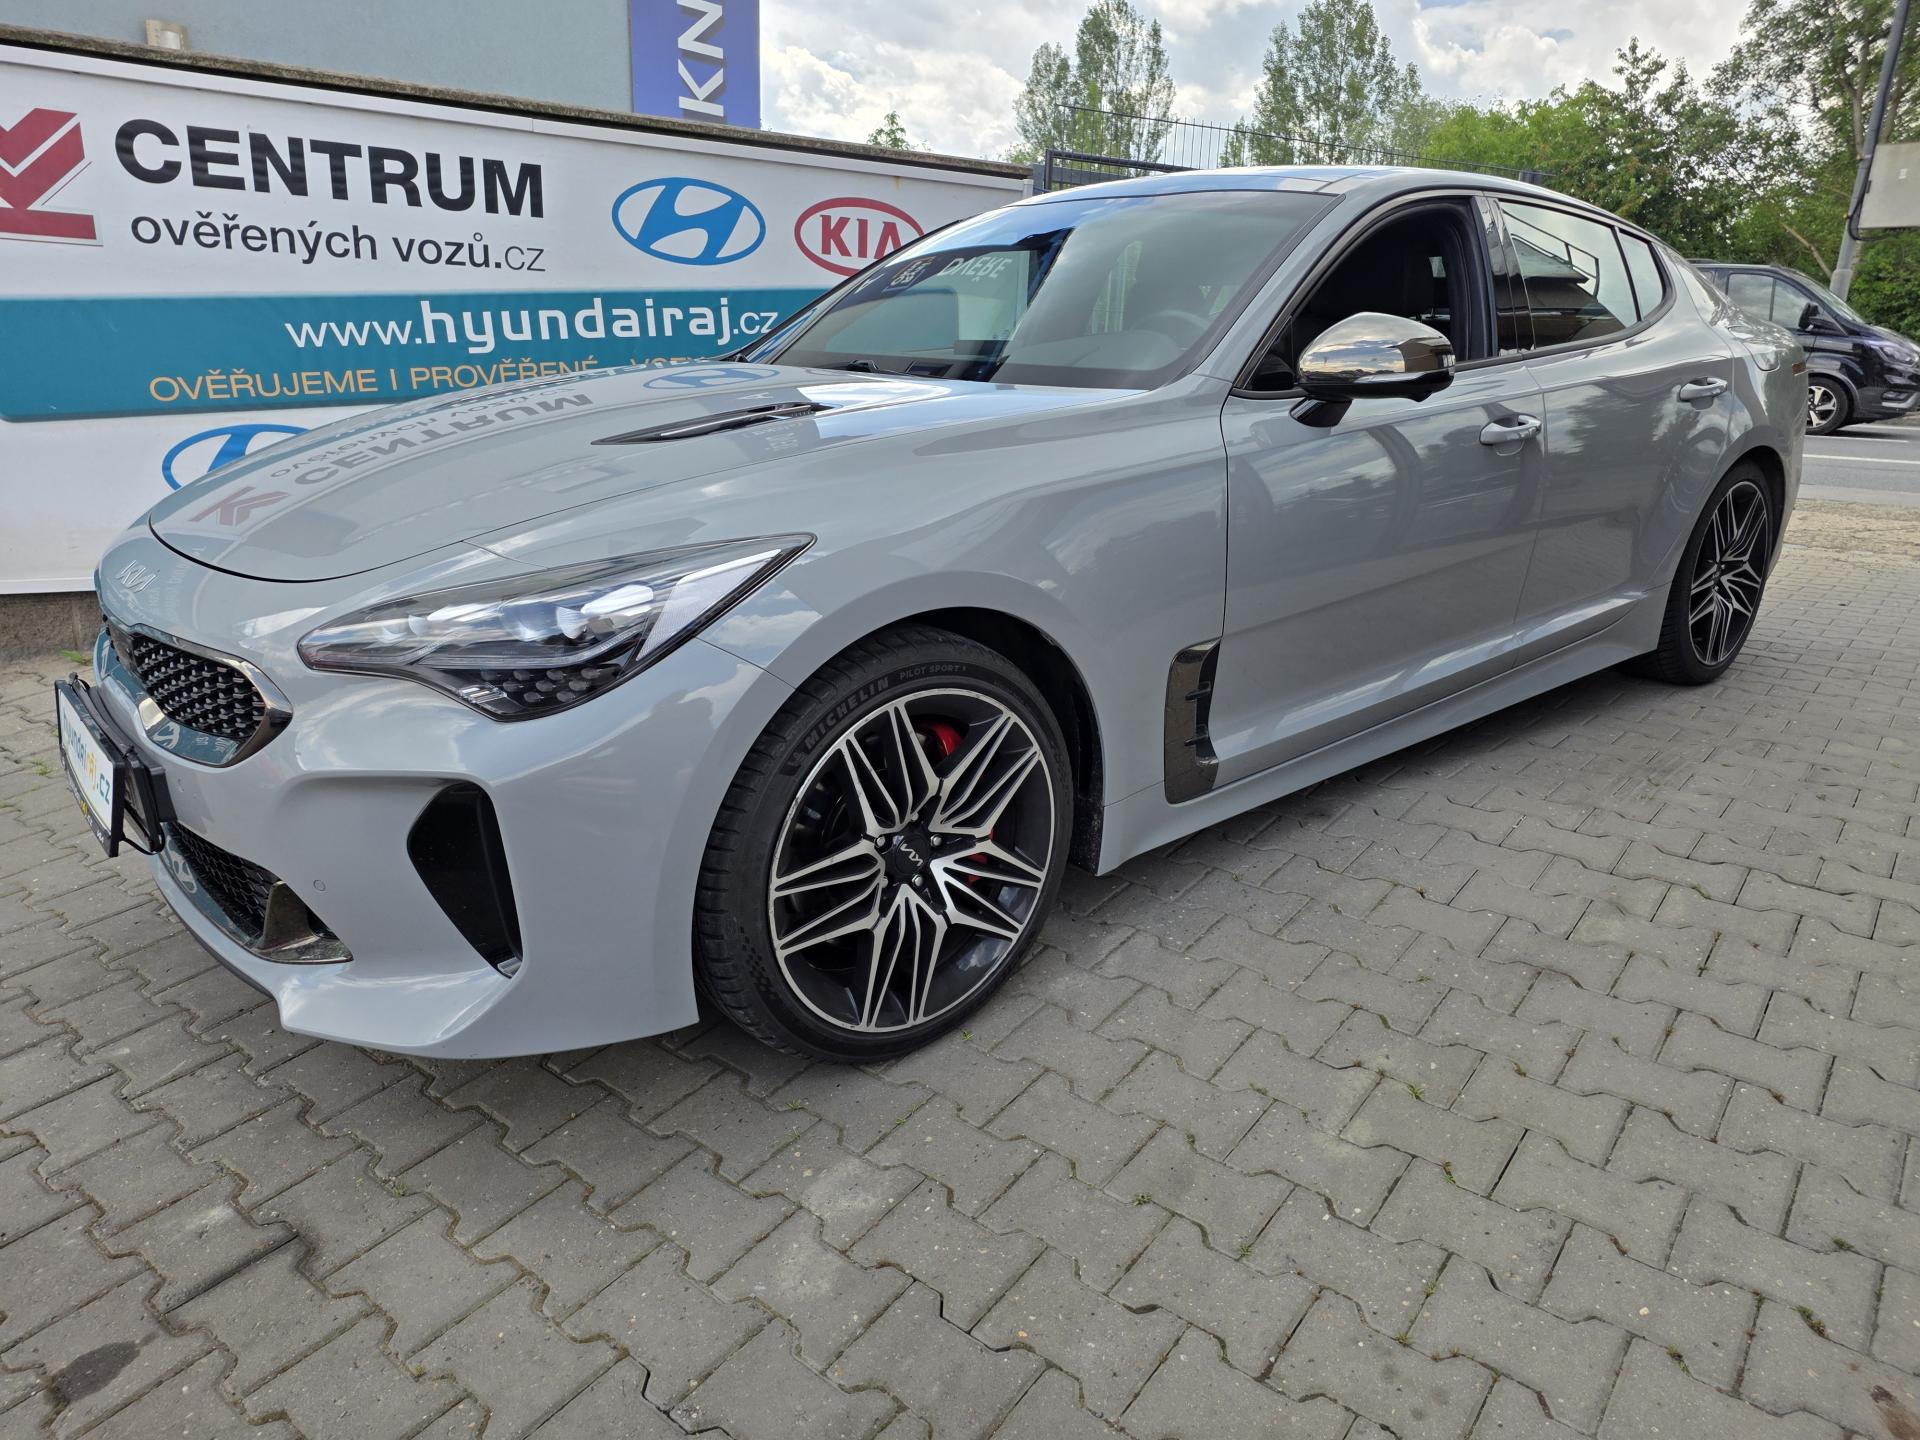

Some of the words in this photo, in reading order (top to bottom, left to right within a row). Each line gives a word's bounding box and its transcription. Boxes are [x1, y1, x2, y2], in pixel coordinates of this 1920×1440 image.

[115, 118, 544, 219] CENTRUM
[131, 211, 378, 264] ověřených
[820, 214, 902, 260] KIA
[285, 298, 779, 354] www.hyundairaj.cz
[149, 366, 378, 402] OVĚŘUJEME
[806, 676, 889, 749] MICHELIN
[900, 666, 926, 681] PILOT
[929, 664, 960, 674] SPORT
